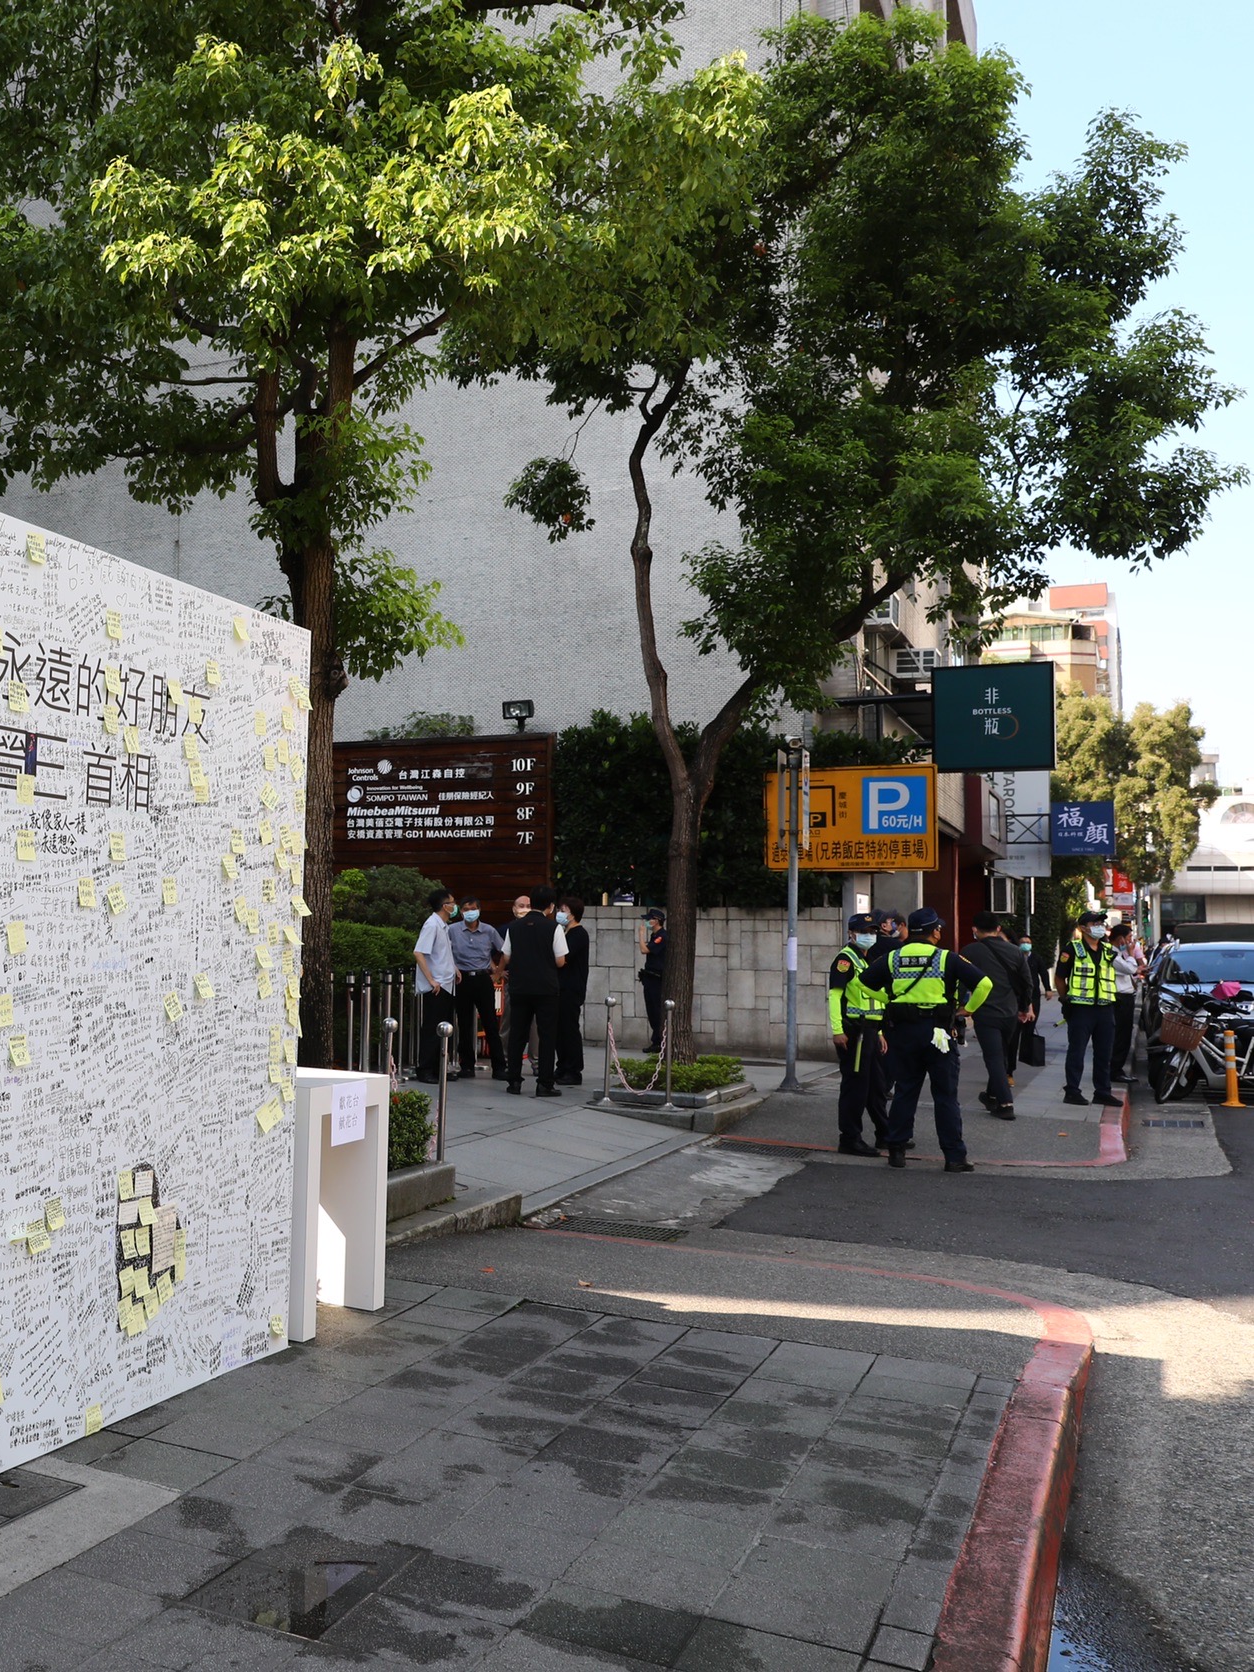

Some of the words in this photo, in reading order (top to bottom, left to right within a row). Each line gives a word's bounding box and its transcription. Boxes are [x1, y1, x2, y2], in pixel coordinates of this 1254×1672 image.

[984, 687, 1000, 705] 非
[972, 707, 1012, 716] BOTTLESS
[348, 767, 374, 775] Johnson
[511, 758, 536, 772] 10F
[398, 768, 465, 780] 台灣江森自控
[516, 782, 534, 795] 9F
[347, 805, 440, 816] MinebeaMitsumi
[869, 781, 910, 830] P
[517, 807, 534, 820] 8F
[882, 815, 922, 829] 60元/H
[426, 829, 493, 838] MANAGEMENT
[517, 832, 534, 844] 7F
